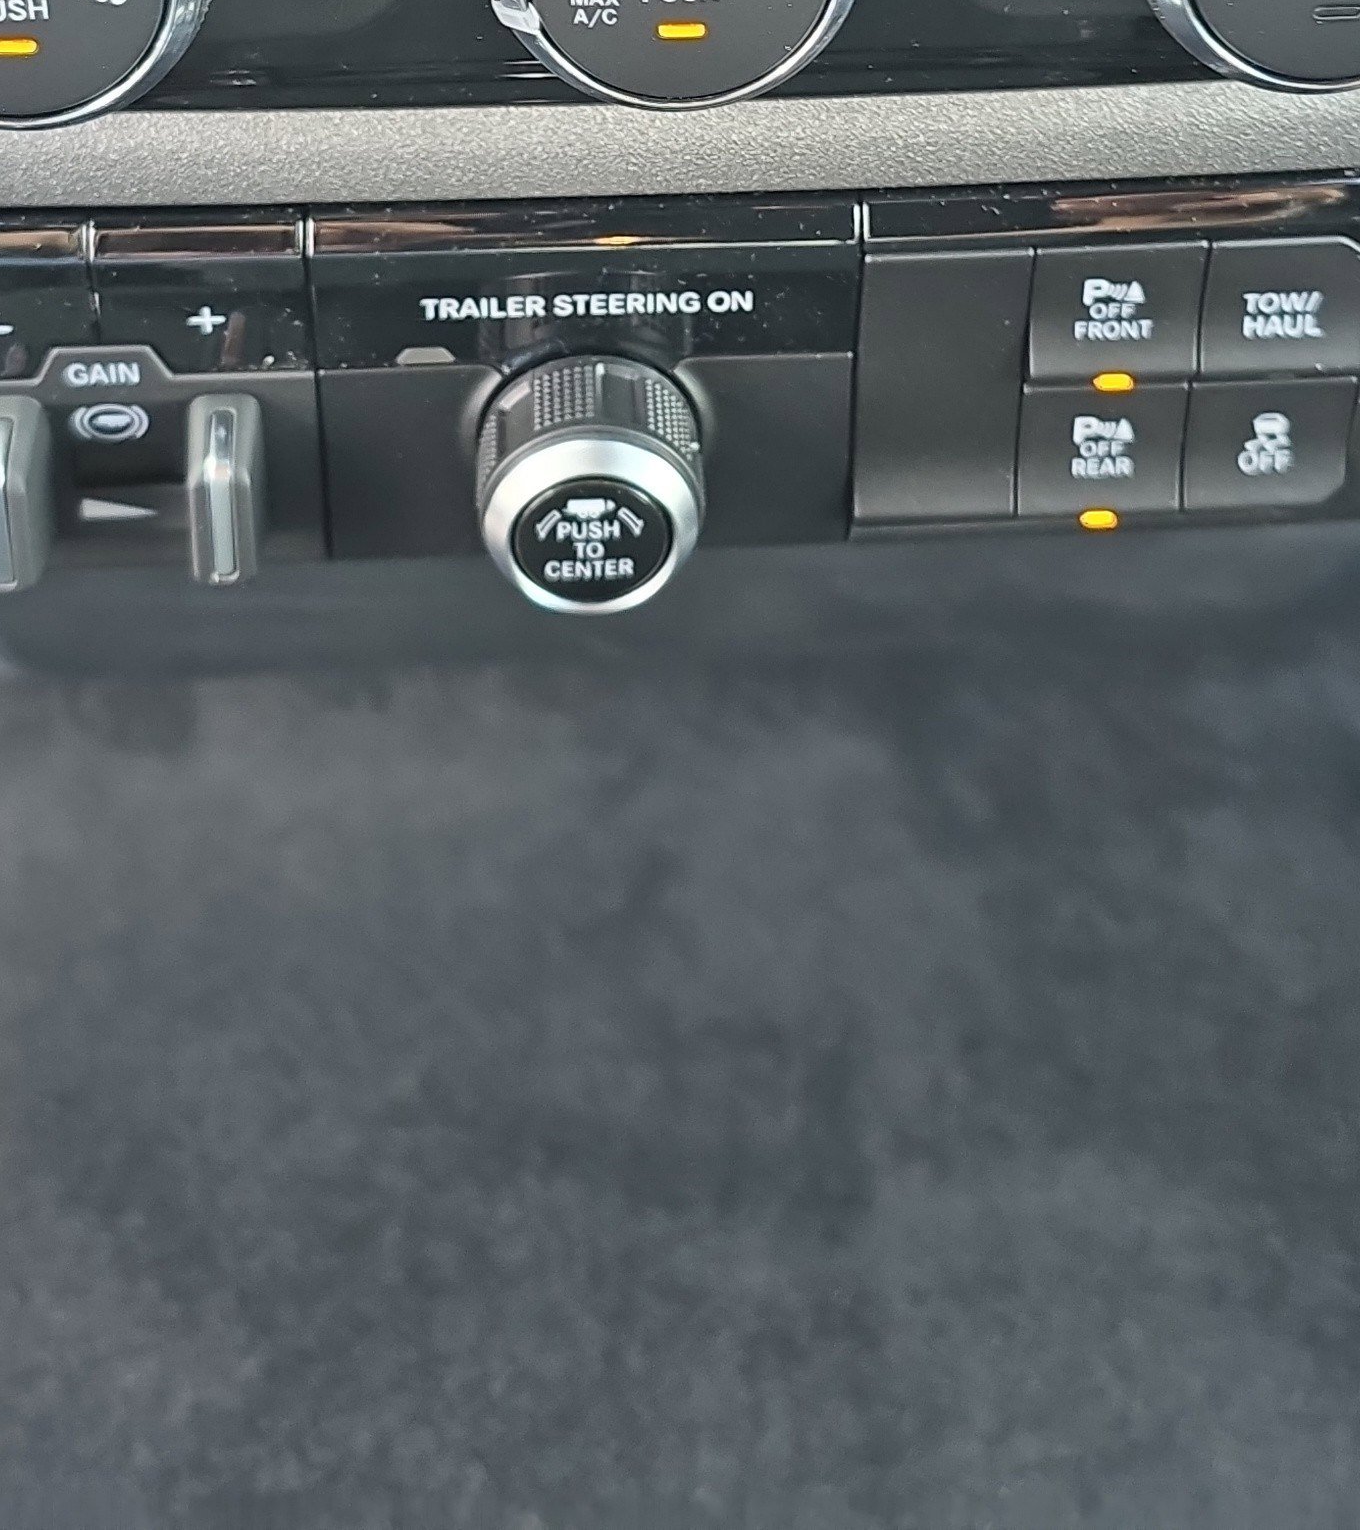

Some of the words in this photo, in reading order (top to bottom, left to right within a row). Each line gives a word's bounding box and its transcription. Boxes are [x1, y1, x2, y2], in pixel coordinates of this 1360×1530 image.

[573, 7, 618, 29] A/C
[419, 295, 546, 320] TRAILER
[552, 291, 701, 317] STEERING
[707, 290, 754, 313] ON
[1089, 302, 1136, 320] OFF
[1242, 290, 1324, 315] TOW/
[1073, 318, 1154, 341] FRONT
[1242, 313, 1325, 339] HAUL
[64, 361, 141, 386] GAIN
[1079, 440, 1125, 458] OFF
[1071, 456, 1135, 479] REAR
[1238, 449, 1293, 476] OFF
[555, 519, 621, 542] PUSH
[572, 541, 605, 559] TO
[543, 557, 634, 582] CENTER
